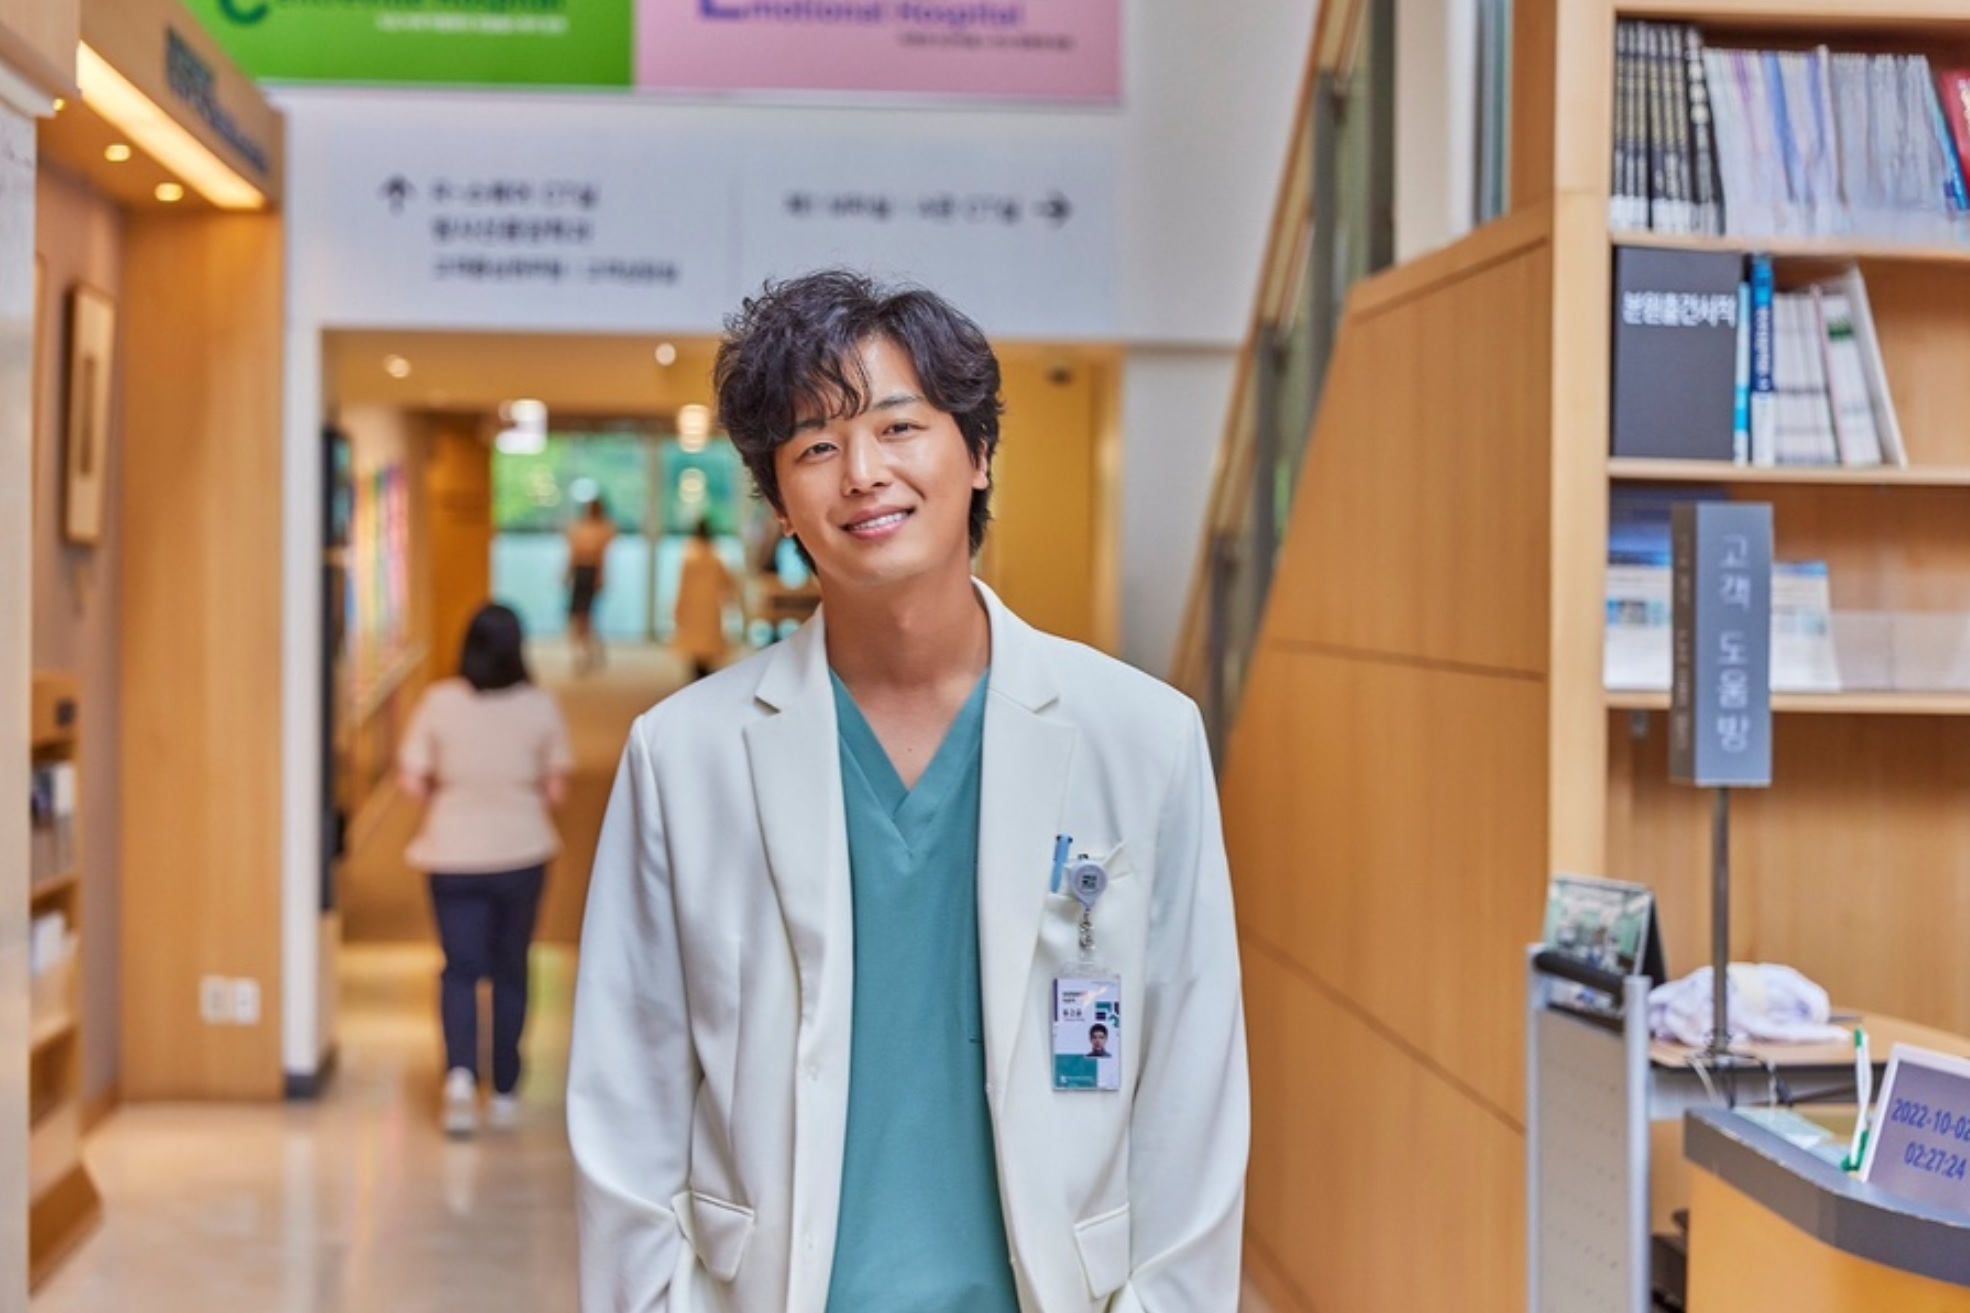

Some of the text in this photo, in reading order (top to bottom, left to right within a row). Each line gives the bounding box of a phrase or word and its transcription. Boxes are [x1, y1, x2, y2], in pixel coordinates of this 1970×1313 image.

[1717, 533, 1751, 754] 고객 도움방
[1904, 1141, 1967, 1180] 02:27:24
